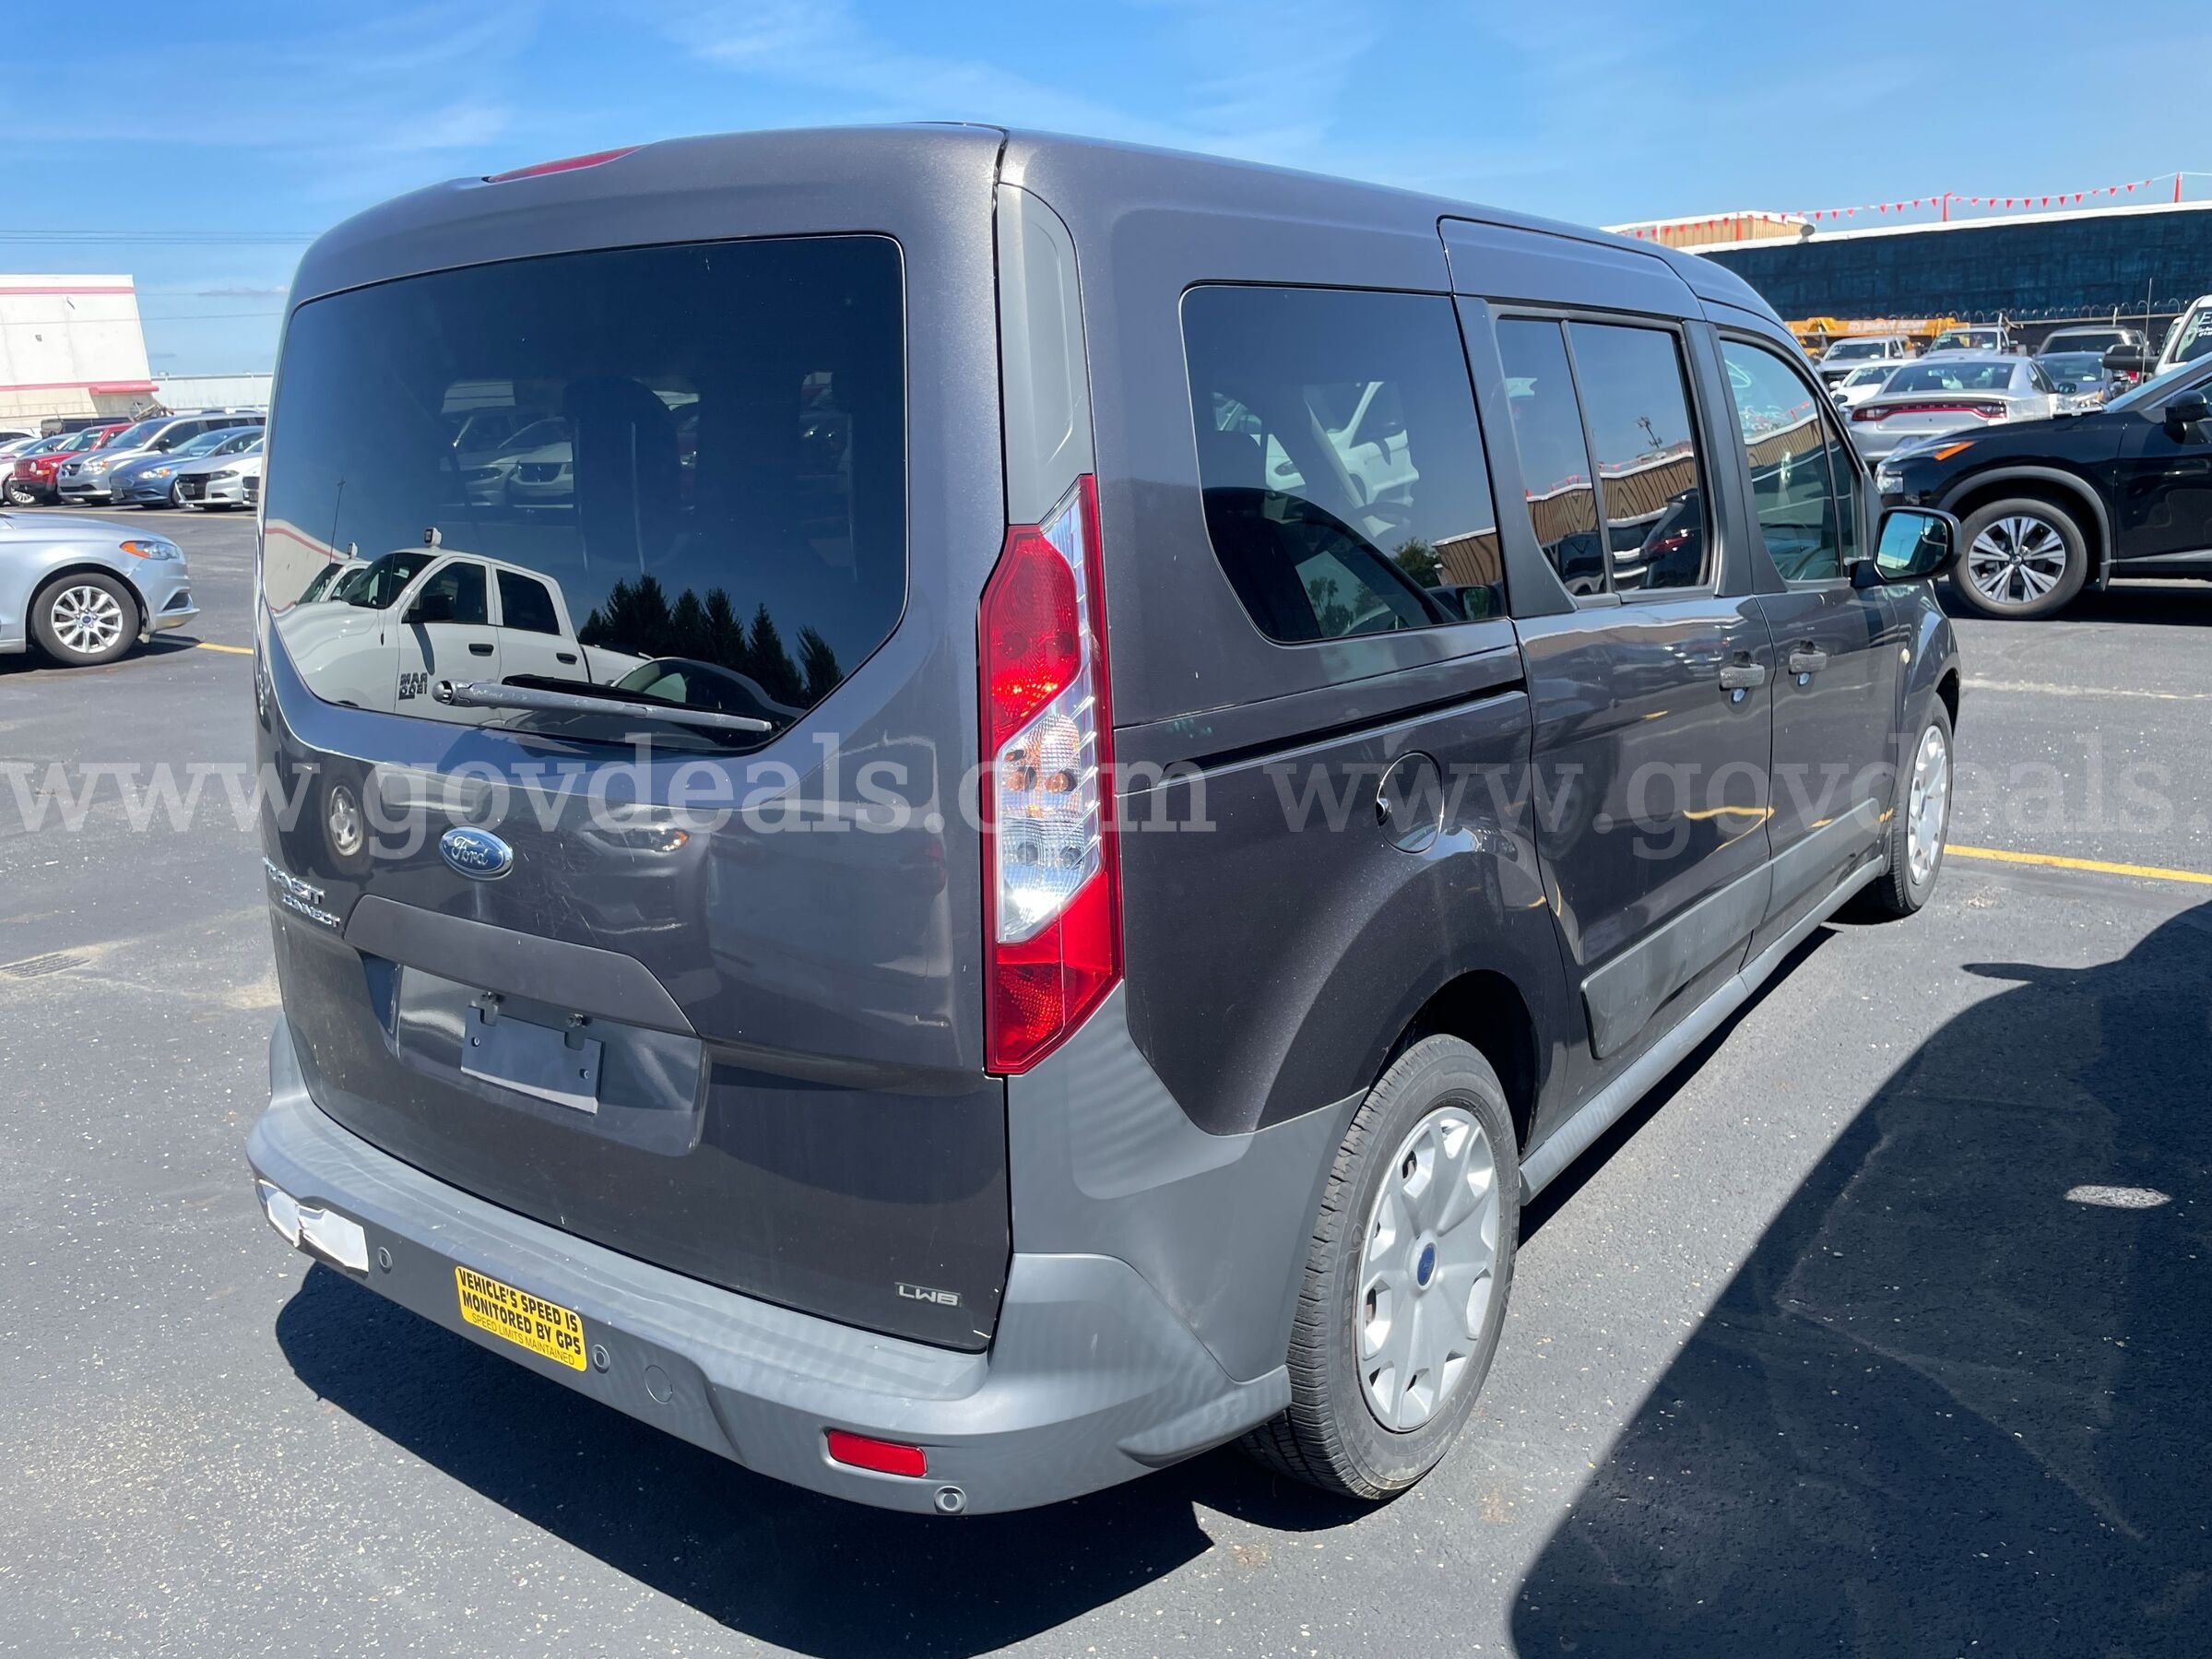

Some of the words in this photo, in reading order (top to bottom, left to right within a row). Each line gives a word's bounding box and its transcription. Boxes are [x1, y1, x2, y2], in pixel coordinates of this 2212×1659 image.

[451, 835, 489, 866] Ford
[458, 1268, 518, 1309] VEHICLE'S
[520, 1295, 562, 1326] SPEED
[565, 1312, 579, 1333] IS
[898, 1285, 959, 1307] LWB
[462, 1290, 532, 1334] MONITORED
[536, 1321, 551, 1343] BY
[556, 1330, 582, 1356] GPS
[472, 1313, 497, 1332] SPEED
[499, 1327, 524, 1344] LIMITS
[526, 1335, 575, 1366] MAINTAINED
